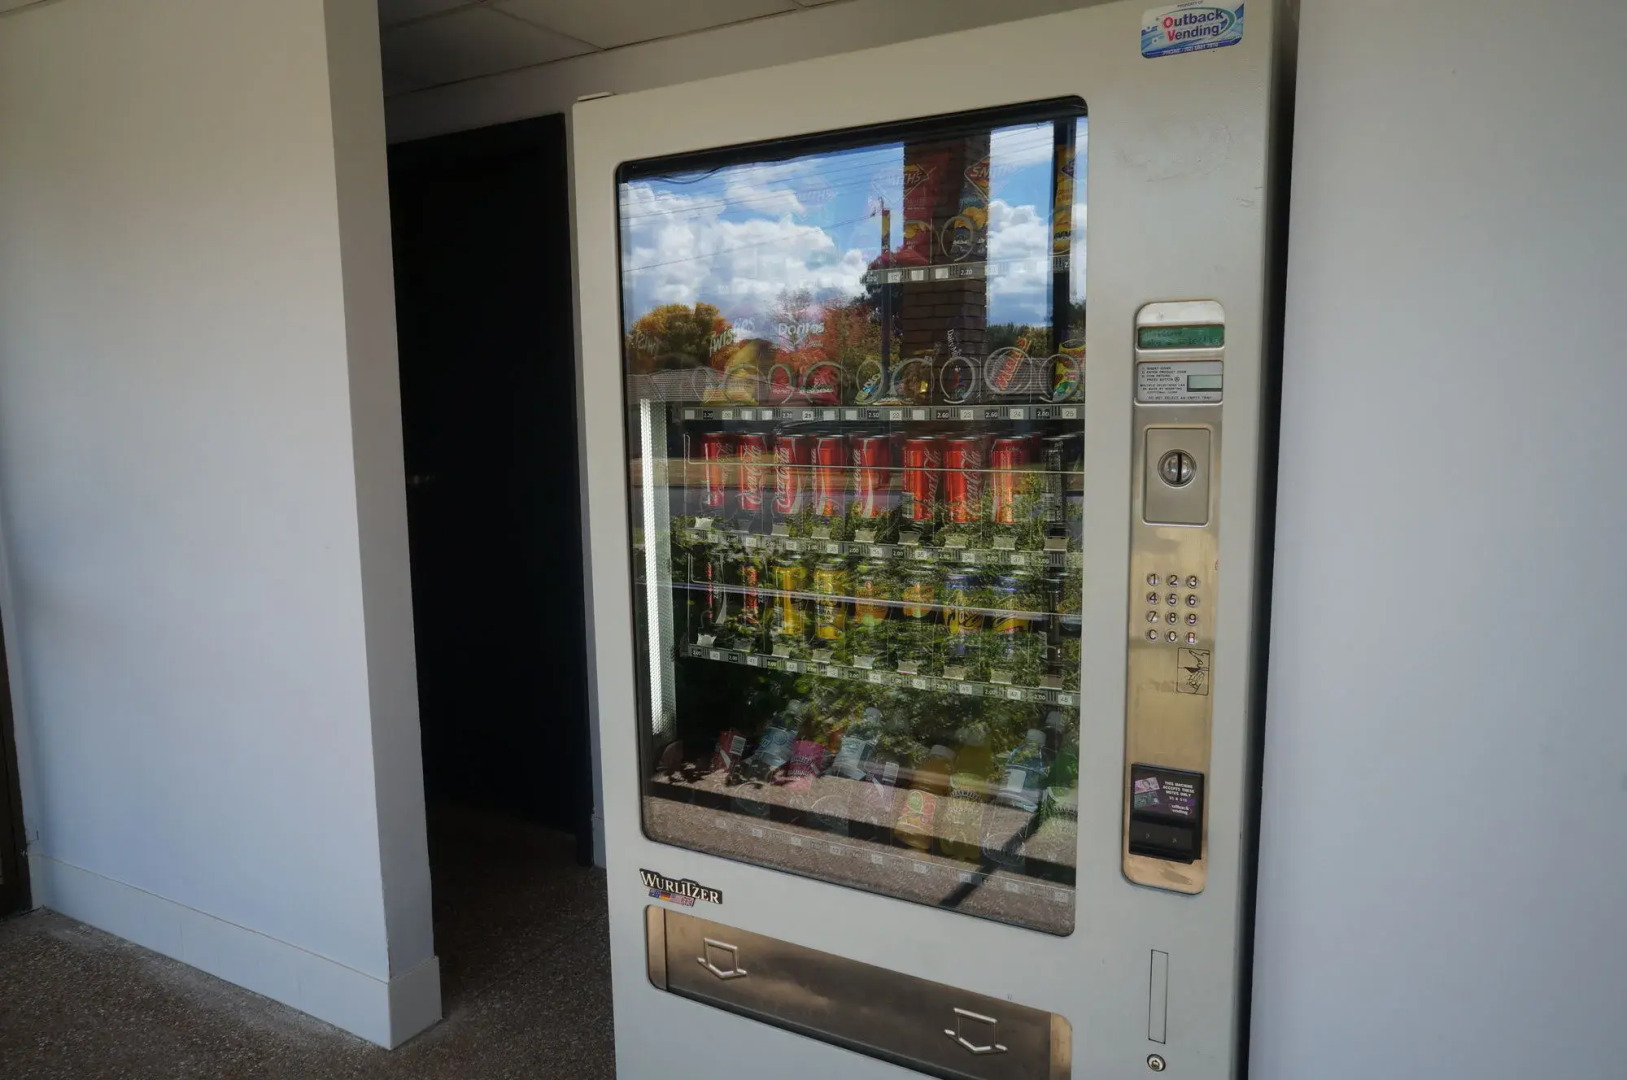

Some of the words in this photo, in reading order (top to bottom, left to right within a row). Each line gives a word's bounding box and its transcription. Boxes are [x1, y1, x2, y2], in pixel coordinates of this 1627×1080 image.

[1163, 8, 1223, 28] Outback
[1167, 25, 1219, 41] Vending
[779, 322, 825, 336] Doritos
[1151, 574, 1156, 584] 1
[1170, 575, 1177, 585] 2
[1190, 576, 1197, 587] 3
[1150, 593, 1157, 603] 4
[1170, 594, 1176, 604] 5
[1189, 595, 1195, 605] 6
[1149, 611, 1156, 622] 7
[1170, 612, 1176, 623] 8
[1189, 614, 1196, 624] 9
[1149, 629, 1157, 640] C
[640, 871, 719, 903] WURLITZER
